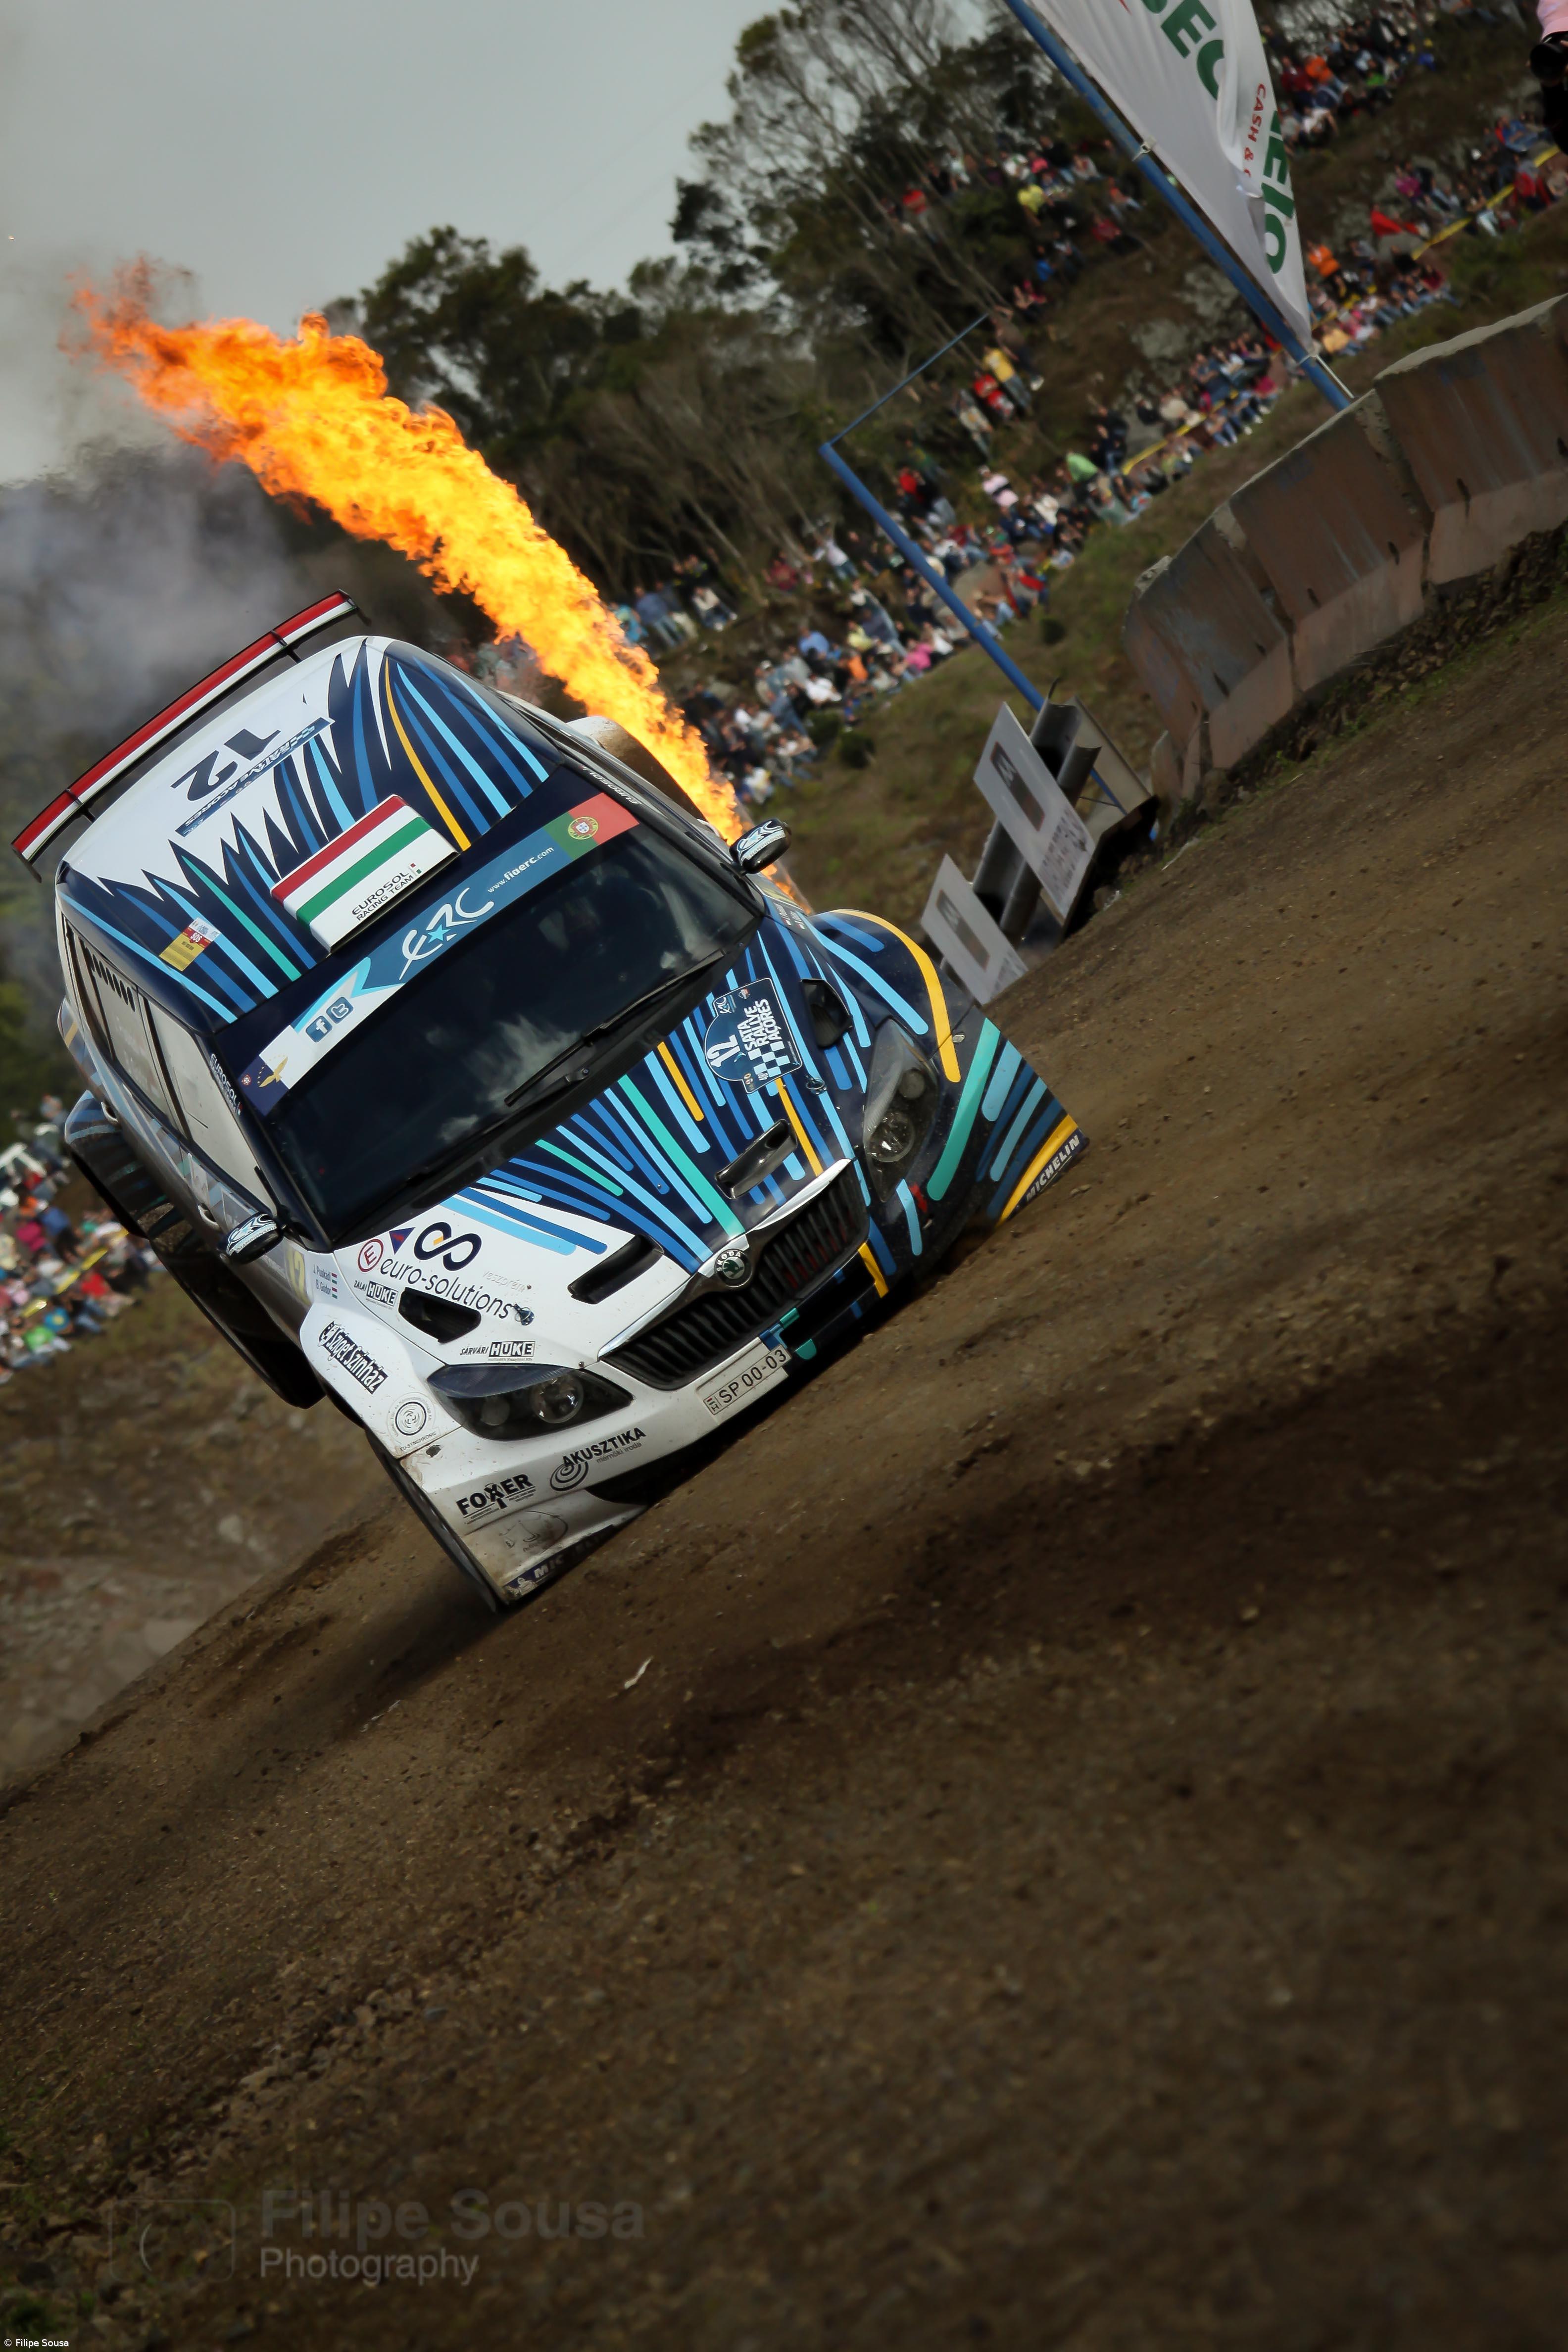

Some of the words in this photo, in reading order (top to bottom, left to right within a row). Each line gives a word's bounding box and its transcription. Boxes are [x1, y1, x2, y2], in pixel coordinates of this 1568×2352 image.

[1247, 84, 1267, 142] CASH
[170, 728, 281, 801] 12
[487, 847, 554, 893] www.fiaerc.com
[352, 872, 409, 915] EUROSOL
[356, 894, 389, 921] RACING
[389, 875, 414, 894] TEAM
[190, 932, 203, 942] SOS
[398, 887, 494, 980] ERC
[737, 1019, 758, 1051] SATA
[743, 1005, 770, 1047] RALLYE
[755, 999, 782, 1040] AÇORES
[707, 1034, 740, 1068] 12
[211, 1053, 237, 1106] EUROSOL
[1027, 1134, 1080, 1201] MICHELIN
[353, 1280, 367, 1291] ZALAI
[366, 1281, 397, 1306] HUKE
[380, 1258, 514, 1319] euro-solutions
[326, 1328, 355, 1361] Sziget
[343, 1346, 386, 1392] Színház
[489, 1341, 535, 1357] HUKE
[719, 1381, 739, 1404] SP
[742, 1349, 786, 1387] 00-03
[400, 1431, 437, 1452] EU-SYNCHRONIC
[562, 1427, 646, 1468] AKUSZTIKA
[624, 1441, 642, 1453] iroda
[456, 1473, 534, 1516] FOXER
